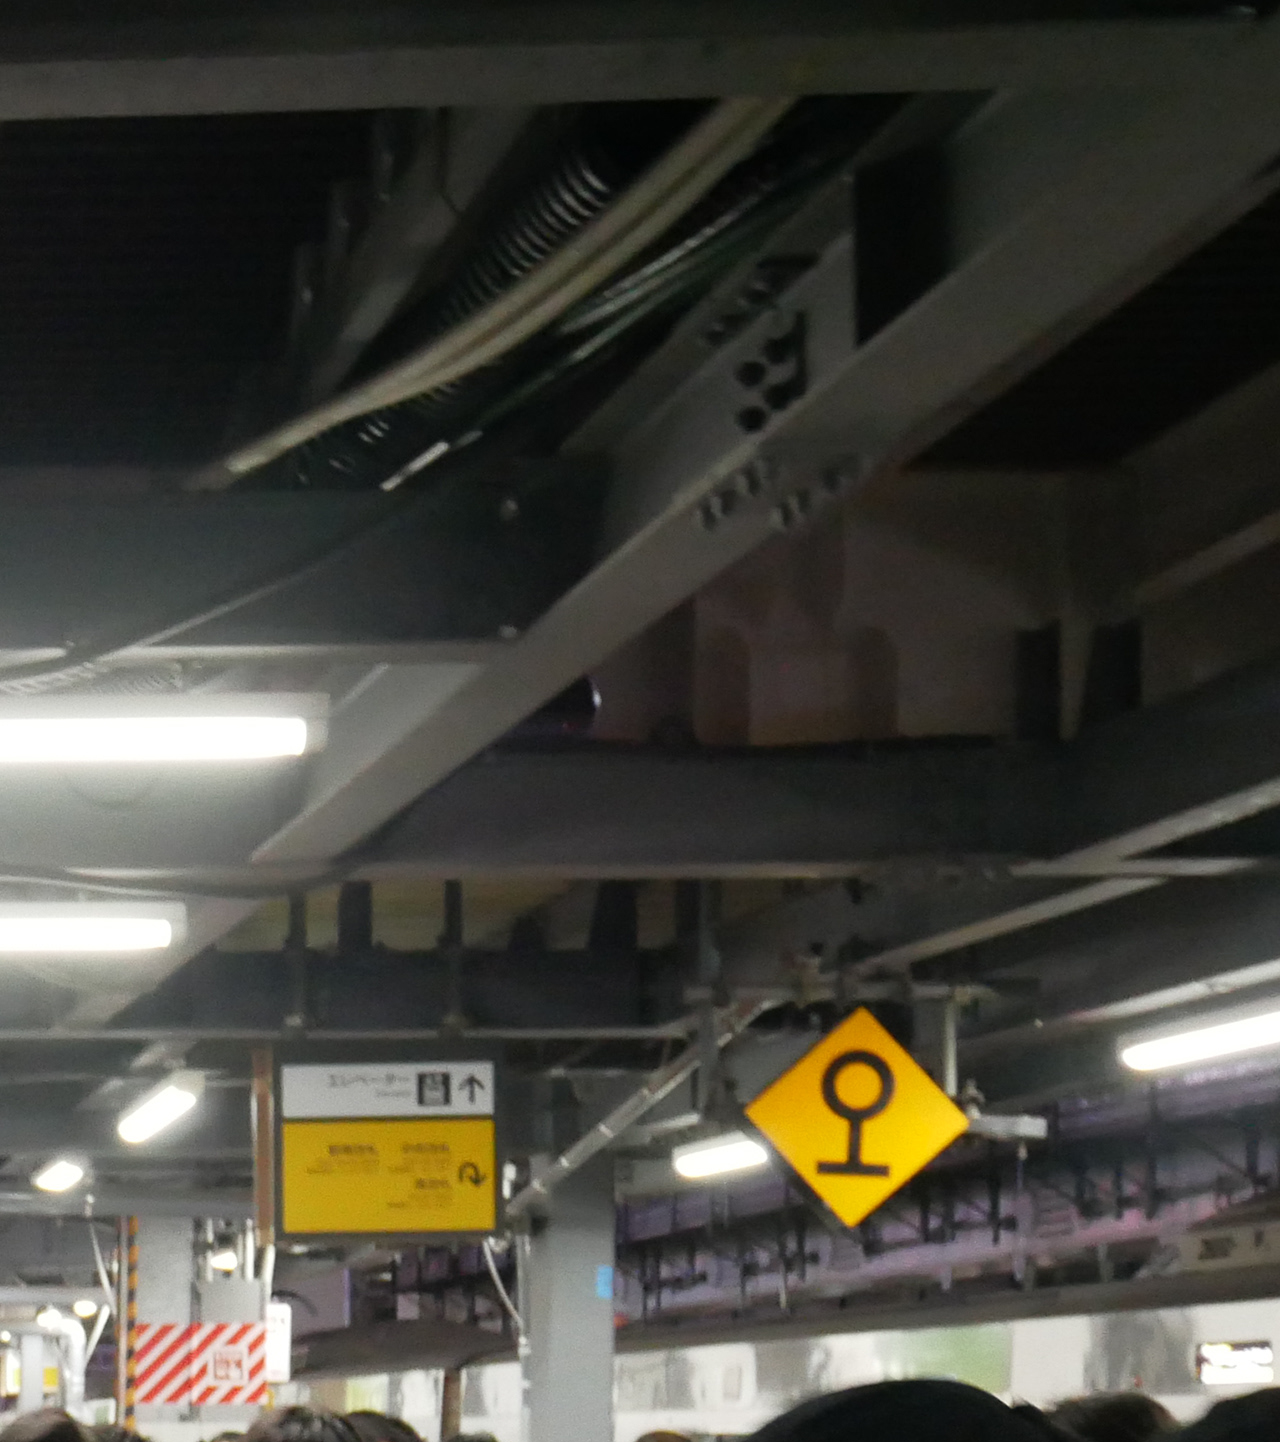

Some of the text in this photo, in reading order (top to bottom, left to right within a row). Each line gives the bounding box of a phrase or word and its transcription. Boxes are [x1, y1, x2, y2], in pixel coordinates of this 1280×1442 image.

[329, 1072, 410, 1087] エレベーター
